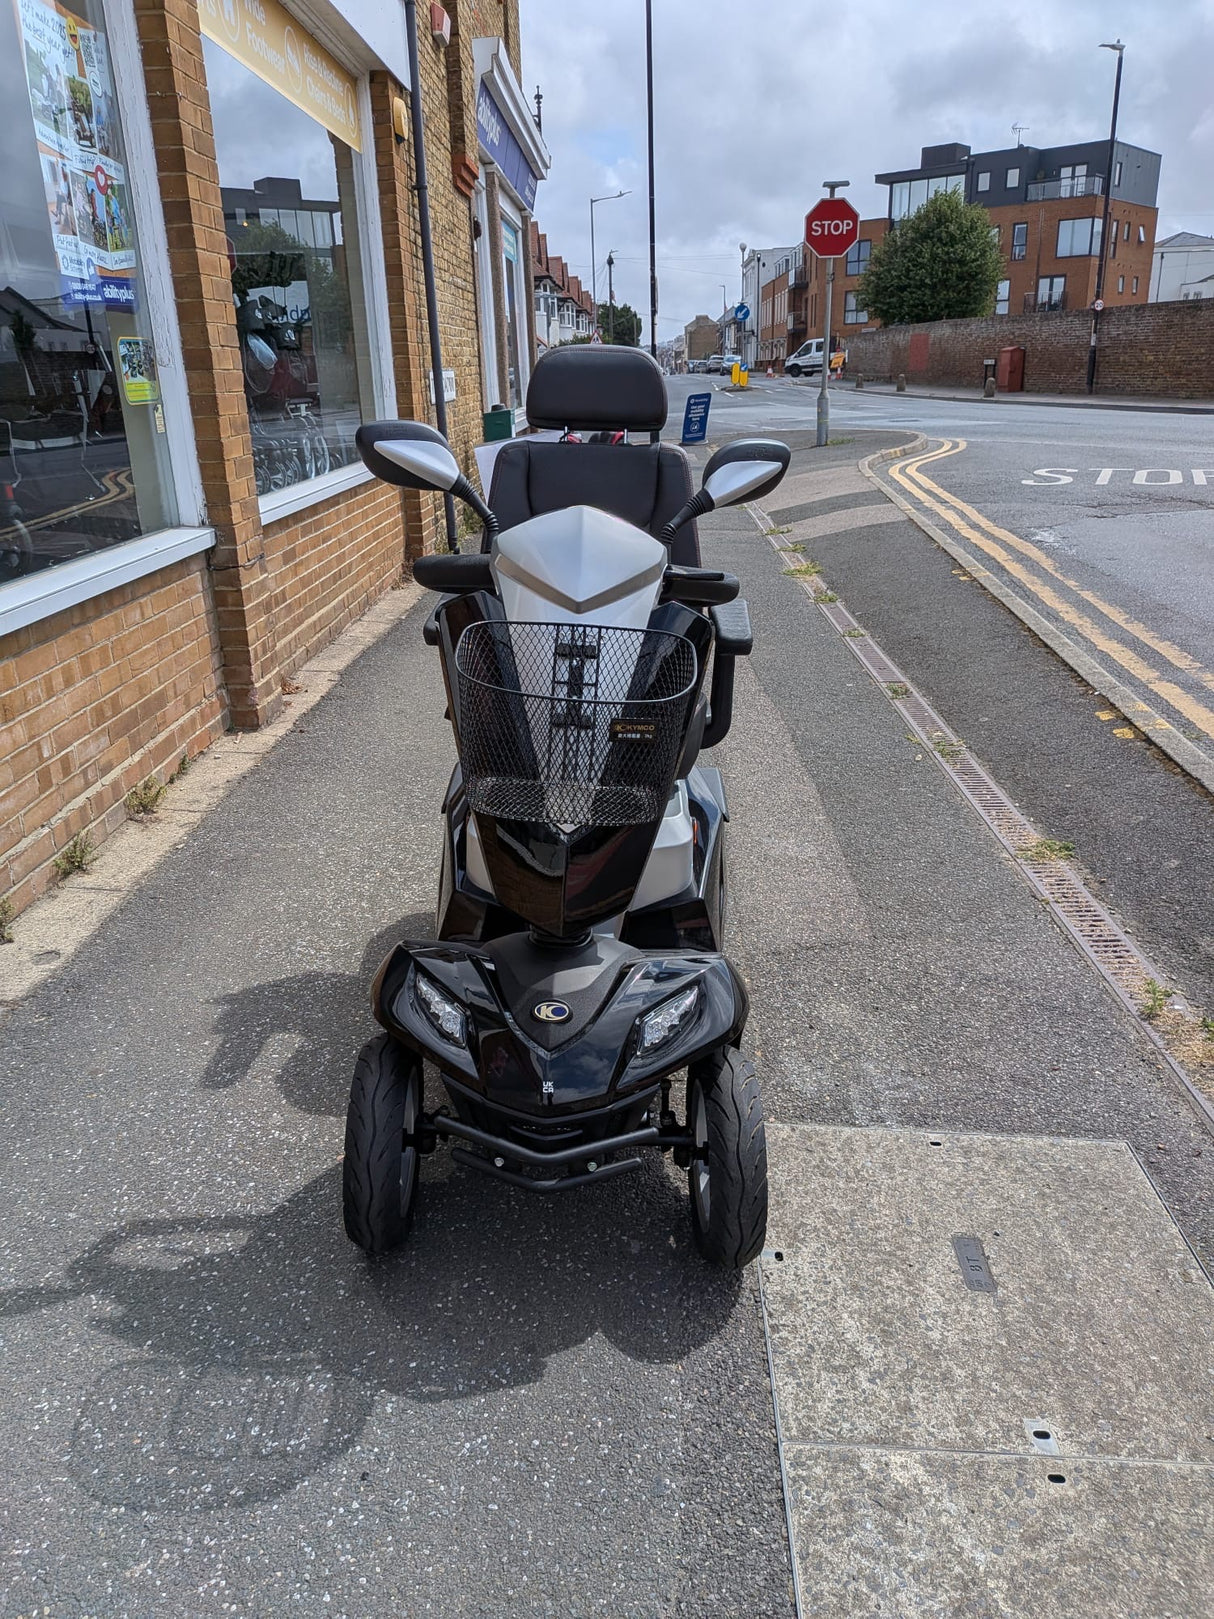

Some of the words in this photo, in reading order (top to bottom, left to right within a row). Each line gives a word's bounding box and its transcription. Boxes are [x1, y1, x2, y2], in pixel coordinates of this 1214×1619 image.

[245, 21, 285, 75] Footwear
[811, 220, 853, 236] STOP
[103, 284, 135, 303] abilityplus
[965, 1256, 983, 1273] BT
